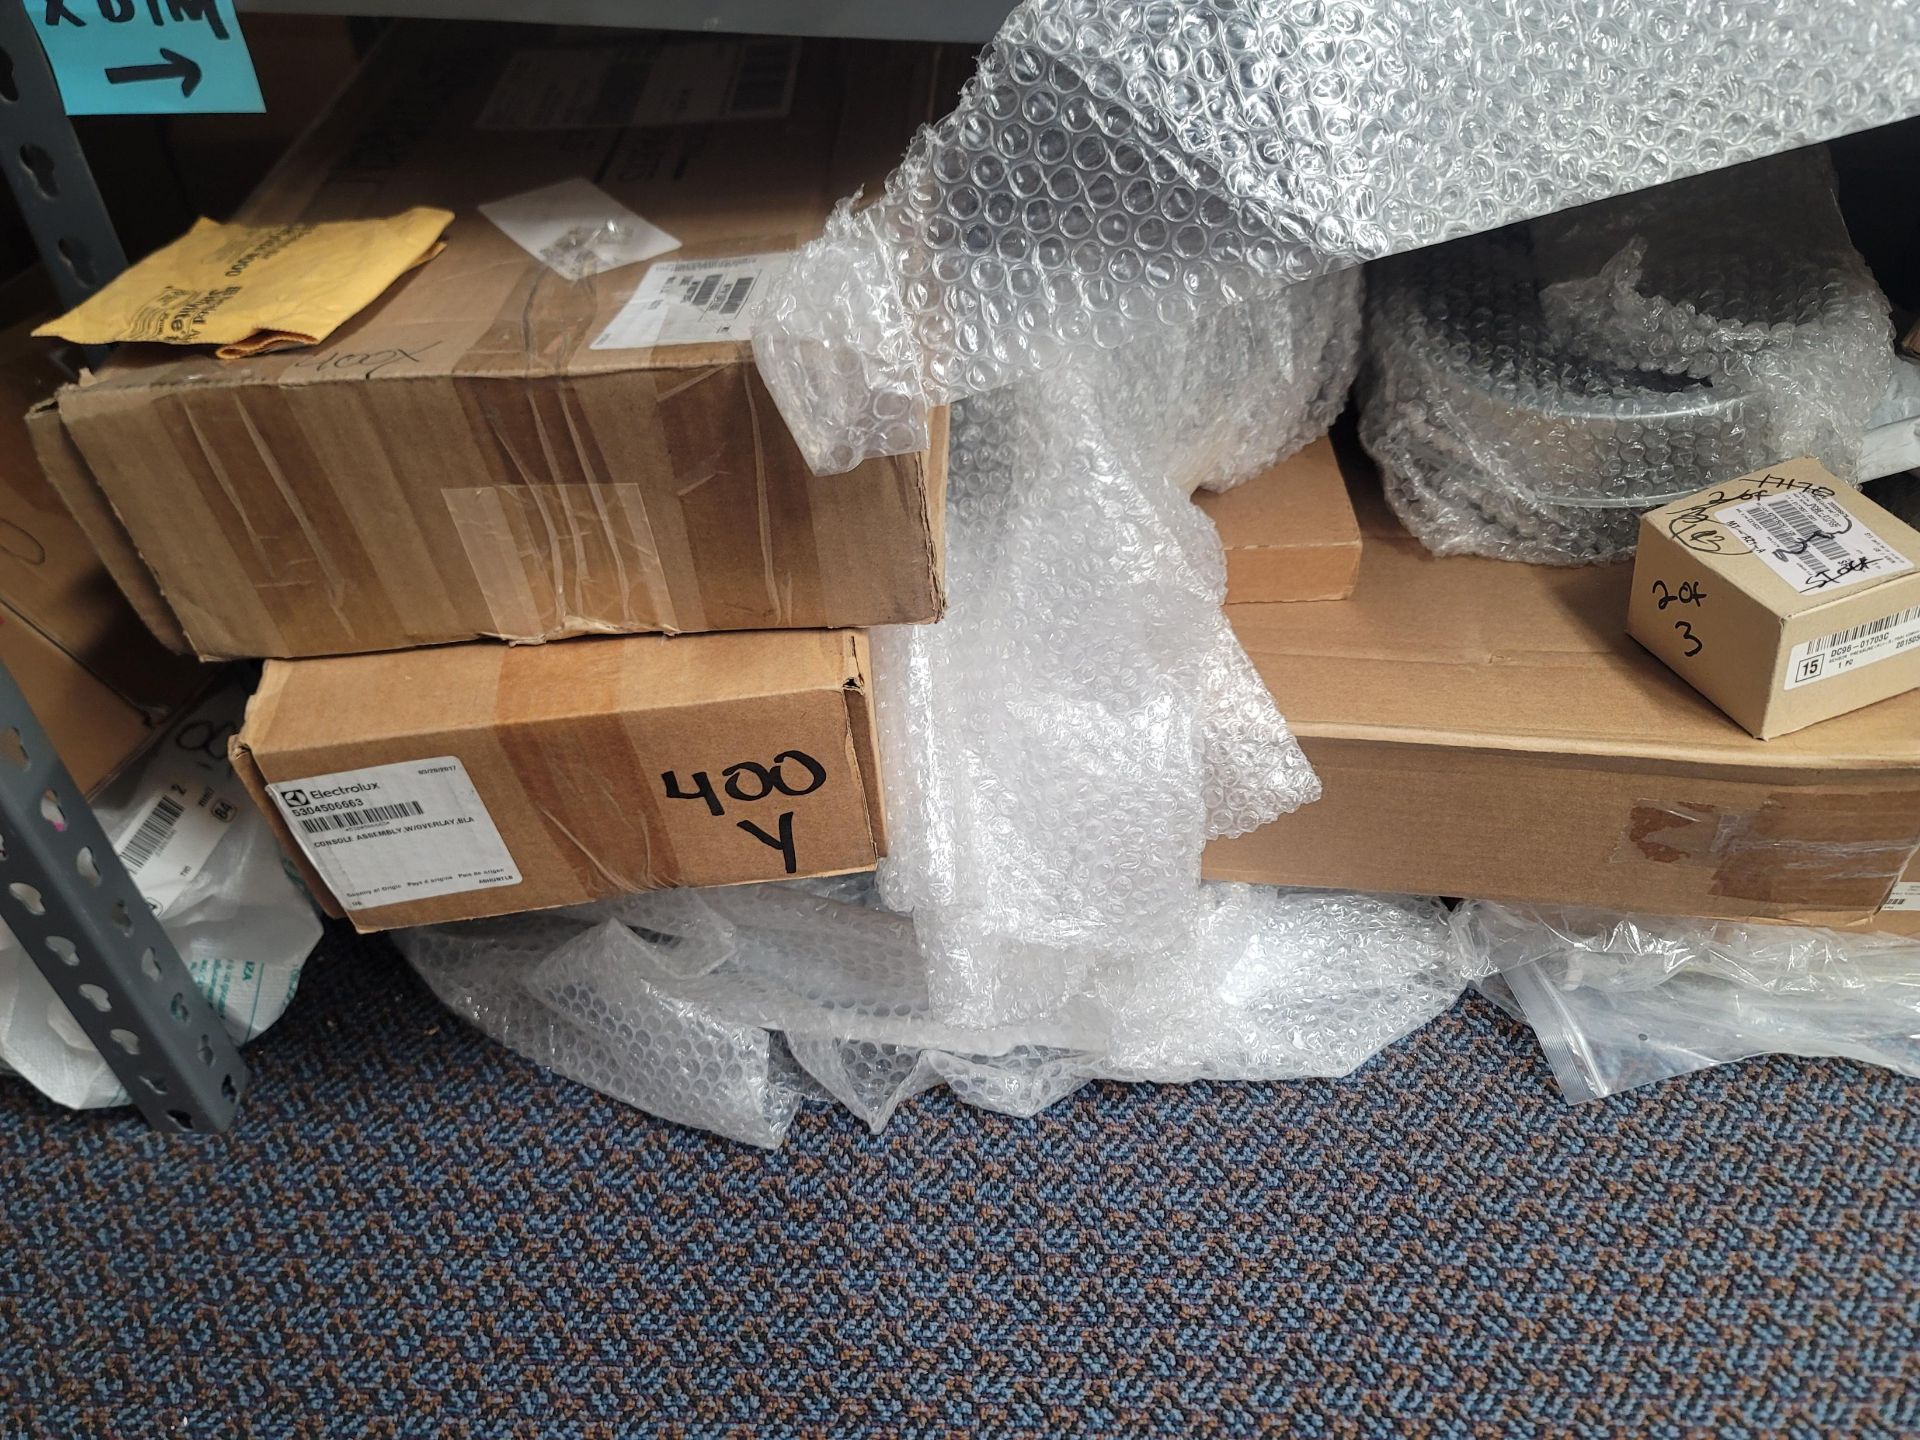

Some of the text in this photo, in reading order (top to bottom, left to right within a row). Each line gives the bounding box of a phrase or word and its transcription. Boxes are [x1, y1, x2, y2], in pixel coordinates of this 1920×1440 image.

[1652, 580, 1678, 610] 2
[1674, 620, 1703, 657] 3
[1803, 659, 1819, 676] 15
[309, 781, 380, 800] Electrolux
[661, 750, 827, 816] 400
[292, 798, 364, 817] 5304506663
[313, 836, 353, 848] CONSOLE
[736, 811, 797, 873] Y
